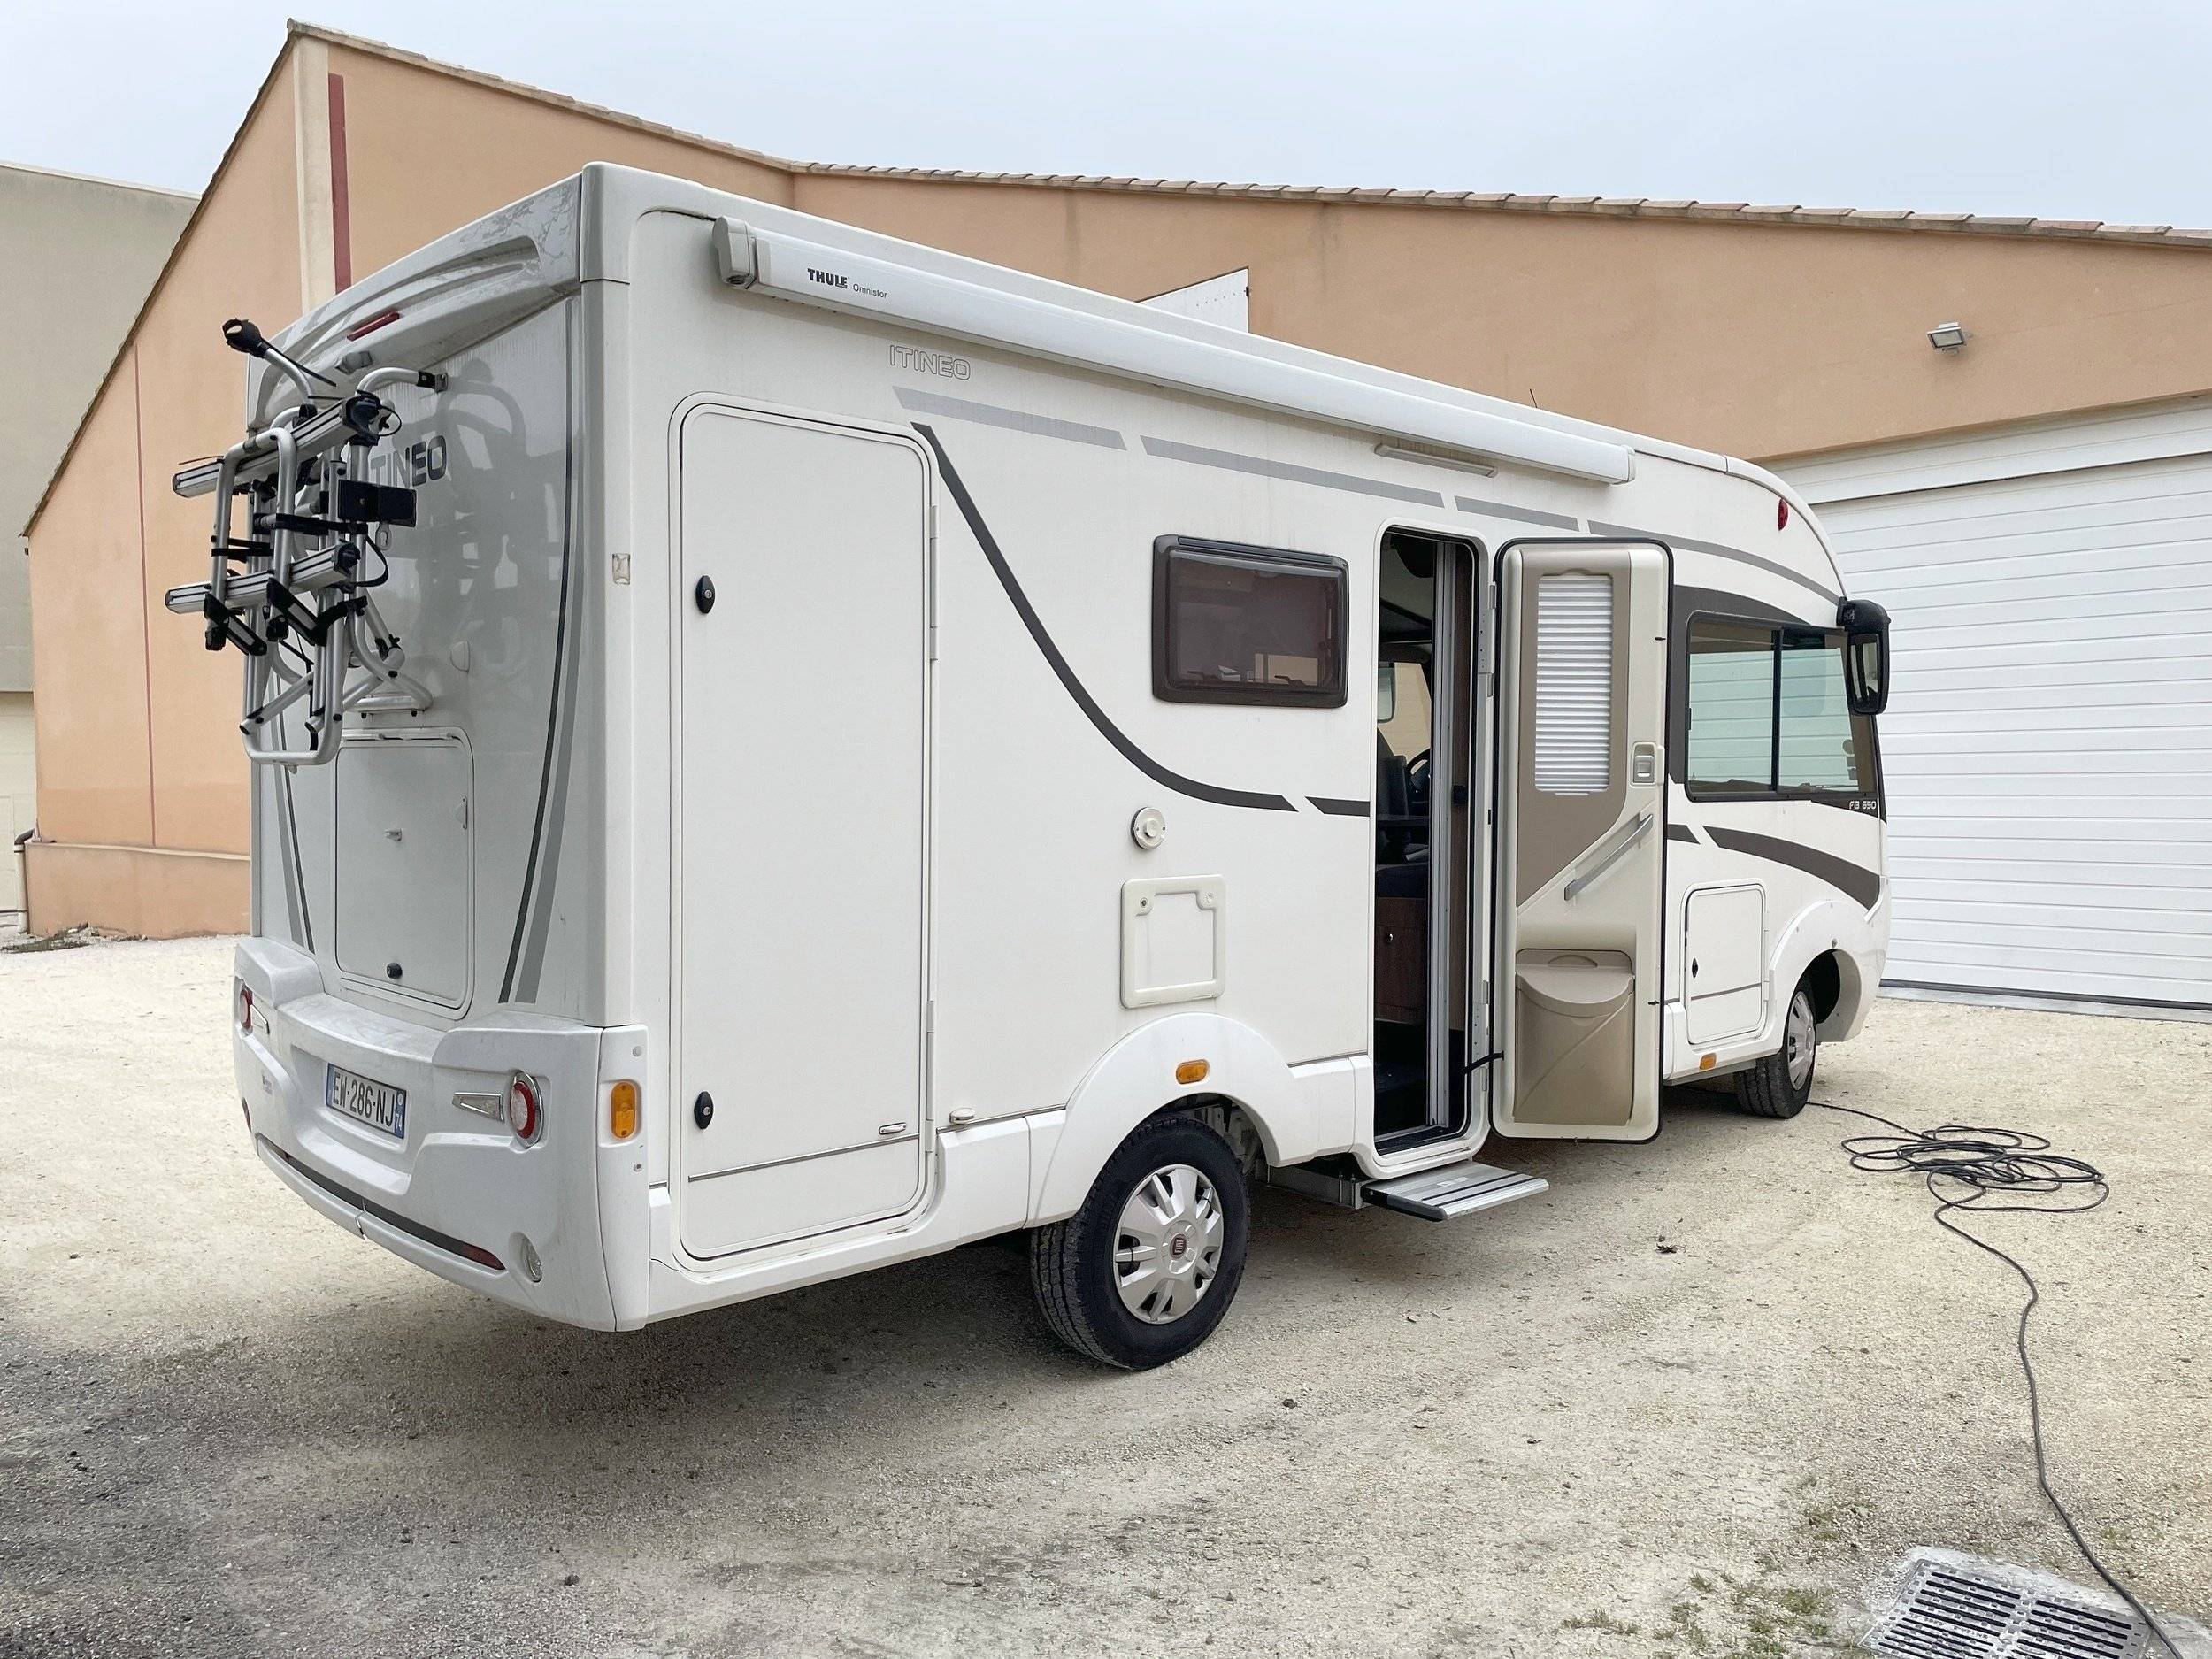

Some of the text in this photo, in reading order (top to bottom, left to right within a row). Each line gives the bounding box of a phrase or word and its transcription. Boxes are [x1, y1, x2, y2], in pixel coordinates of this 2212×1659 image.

[807, 267, 888, 298] THULE Omnistor
[889, 344, 971, 381] ITINEO
[370, 434, 447, 490] TINEO
[1848, 800, 1860, 810] FB
